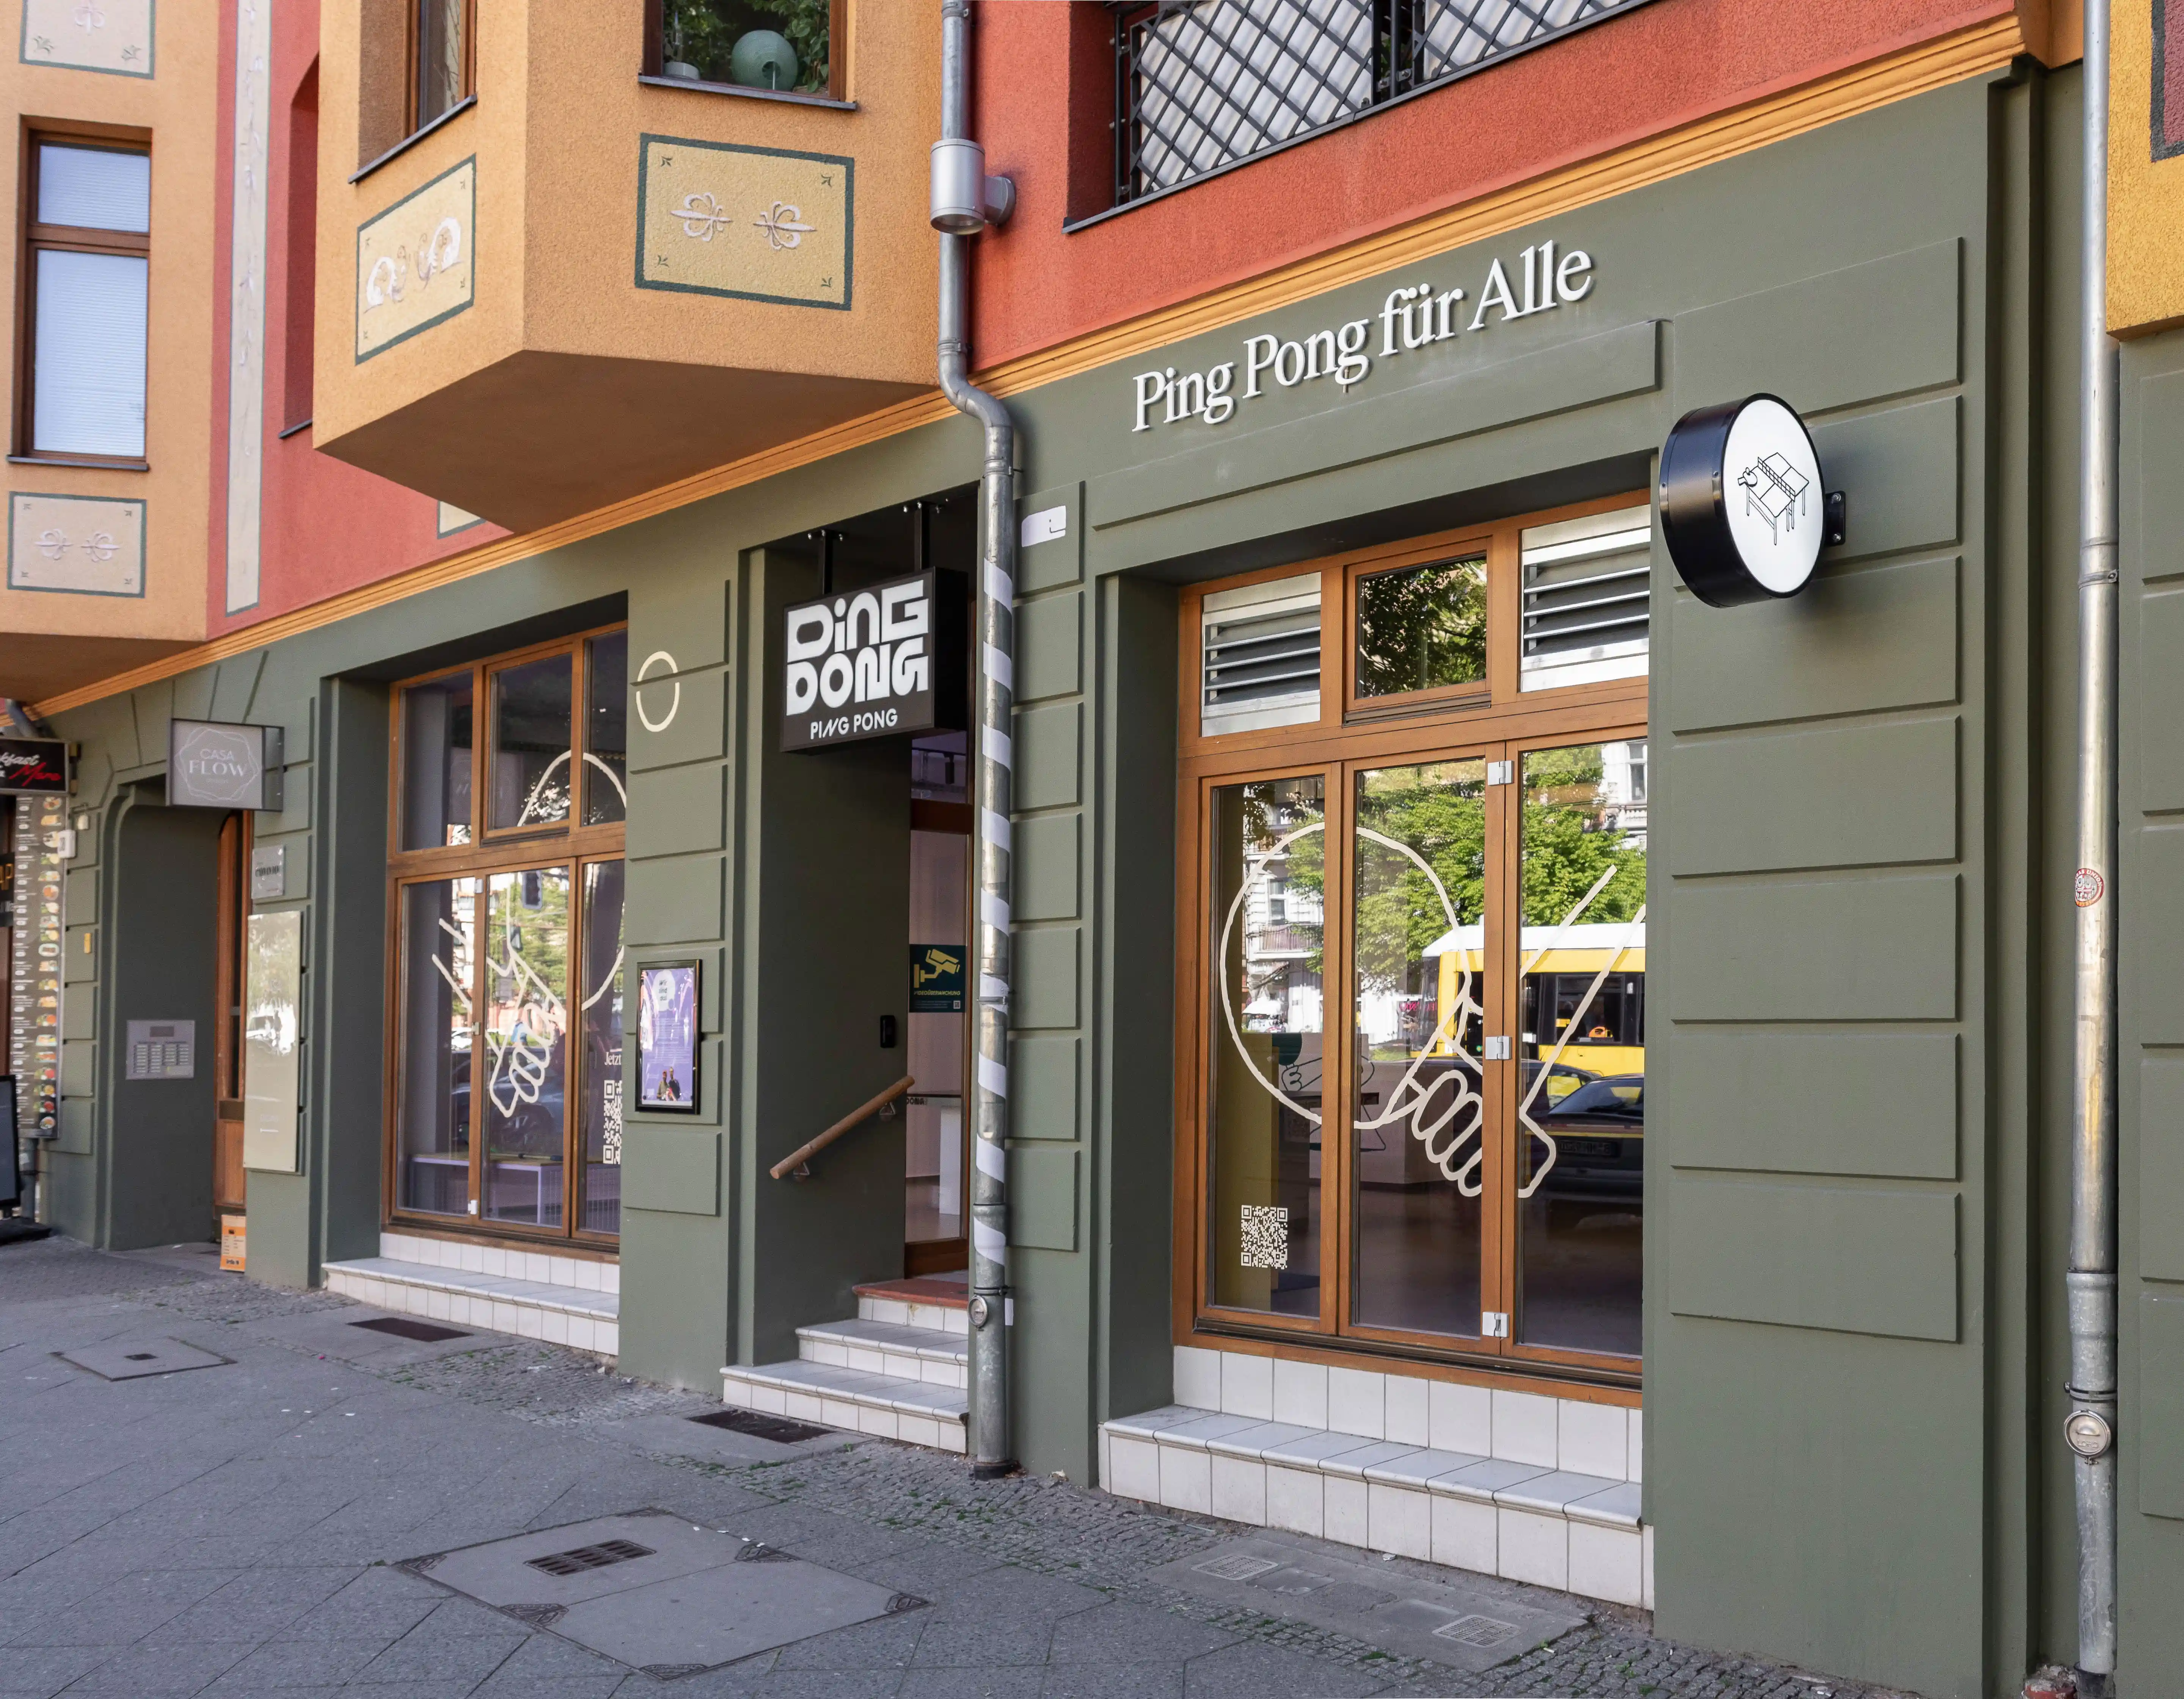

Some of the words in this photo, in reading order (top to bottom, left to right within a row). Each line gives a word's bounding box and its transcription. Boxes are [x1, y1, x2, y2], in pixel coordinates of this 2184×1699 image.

[1132, 361, 1234, 432] Ping
[1242, 318, 1369, 399] Pong
[1379, 283, 1463, 356] für
[1467, 240, 1591, 331] Alle
[810, 717, 849, 740] PING
[854, 708, 898, 732] PONG
[200, 748, 234, 761] CASA
[190, 760, 246, 777] FLOW
[604, 1052, 621, 1065] Jetzt
